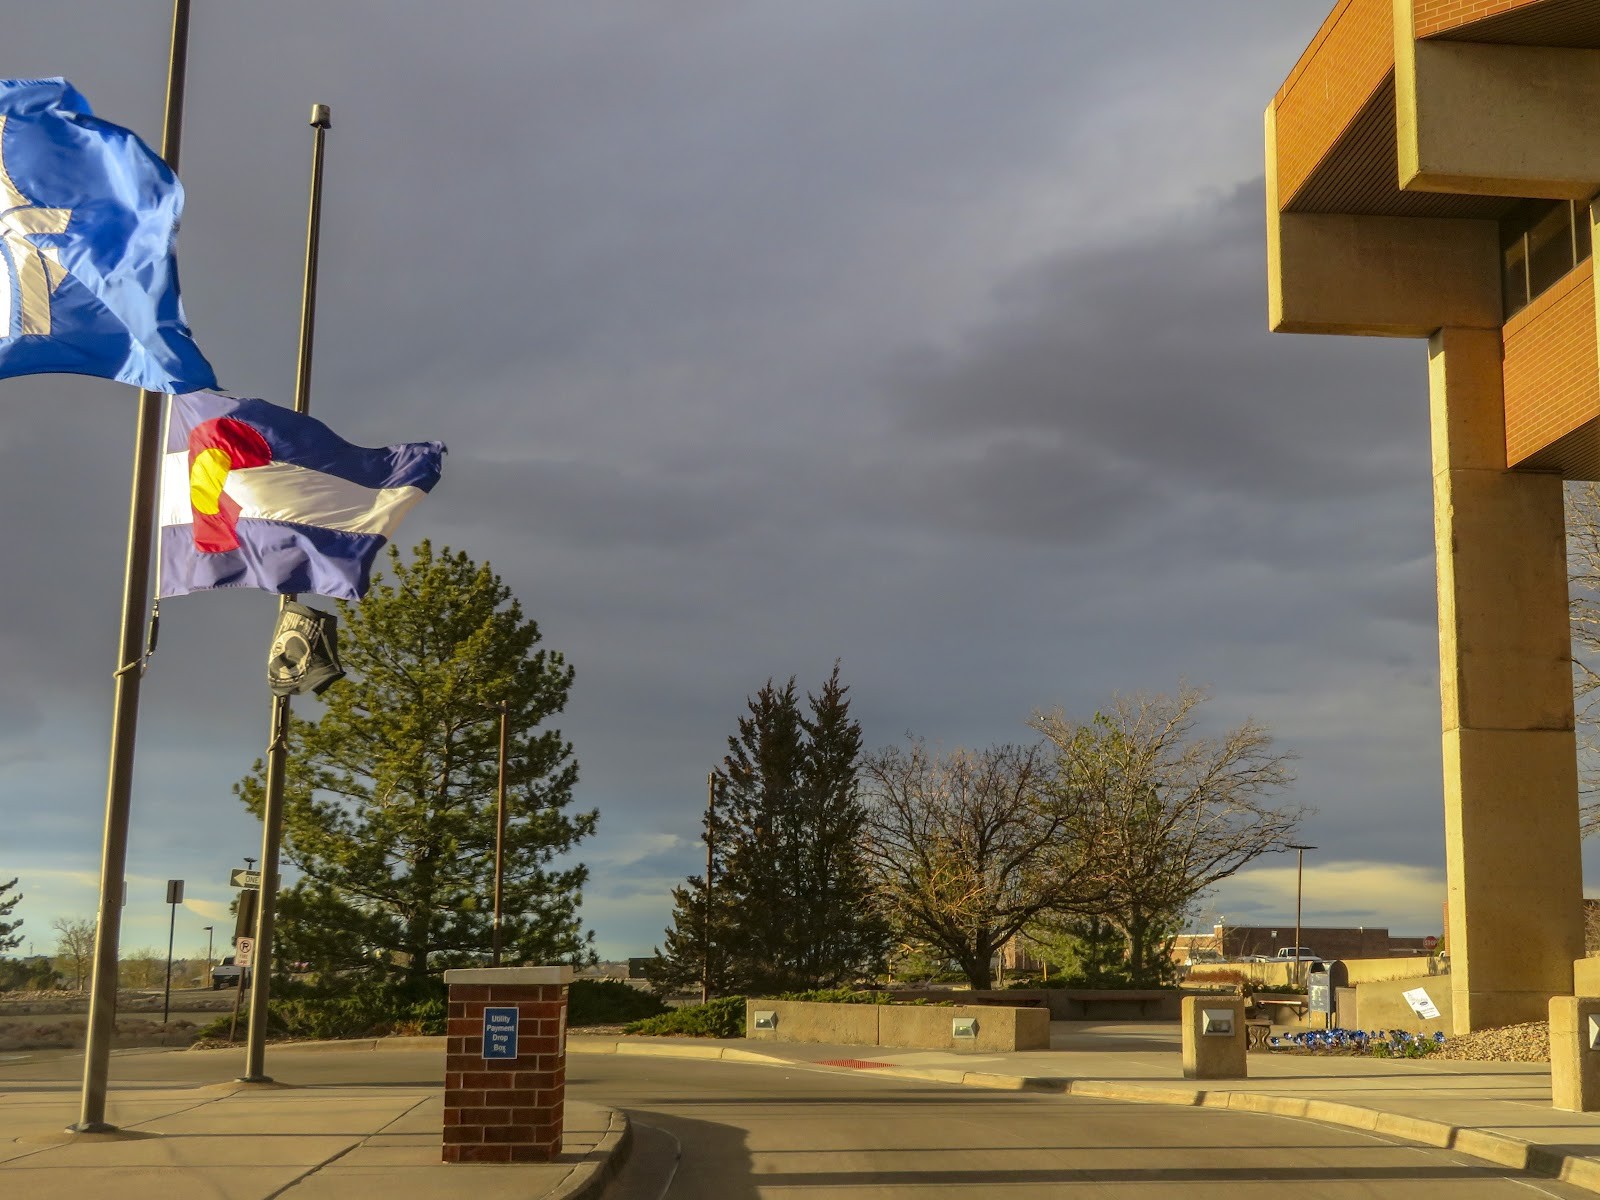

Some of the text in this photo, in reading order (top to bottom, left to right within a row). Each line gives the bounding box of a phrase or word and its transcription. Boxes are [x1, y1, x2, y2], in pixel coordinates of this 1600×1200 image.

[491, 1015, 510, 1023] Utility
[486, 1025, 514, 1033] Payment
[492, 1034, 508, 1042] Drop
[493, 1044, 506, 1052] Box
